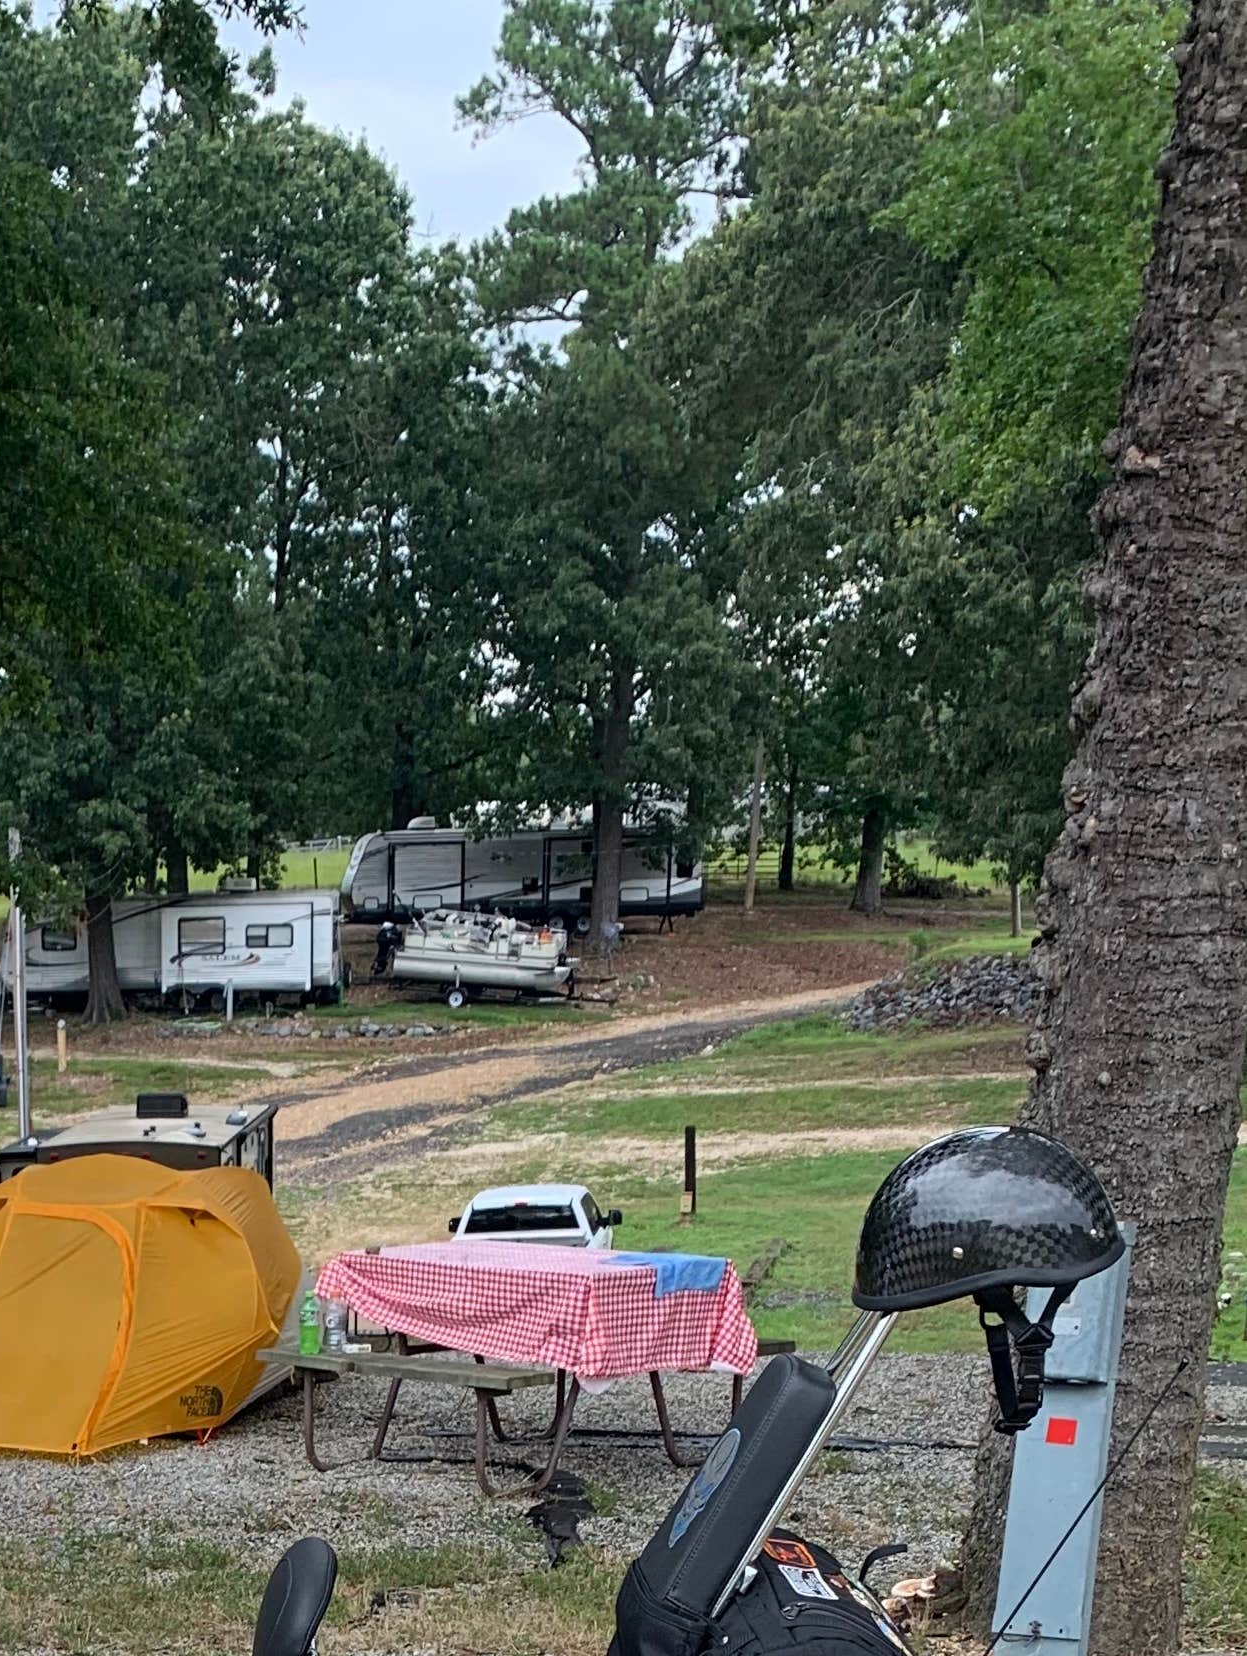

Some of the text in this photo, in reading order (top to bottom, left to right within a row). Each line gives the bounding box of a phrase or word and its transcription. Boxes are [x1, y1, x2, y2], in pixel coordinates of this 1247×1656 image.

[195, 1385, 211, 1396] THE
[180, 1396, 212, 1406] NORTH
[187, 1406, 210, 1416] FACE
